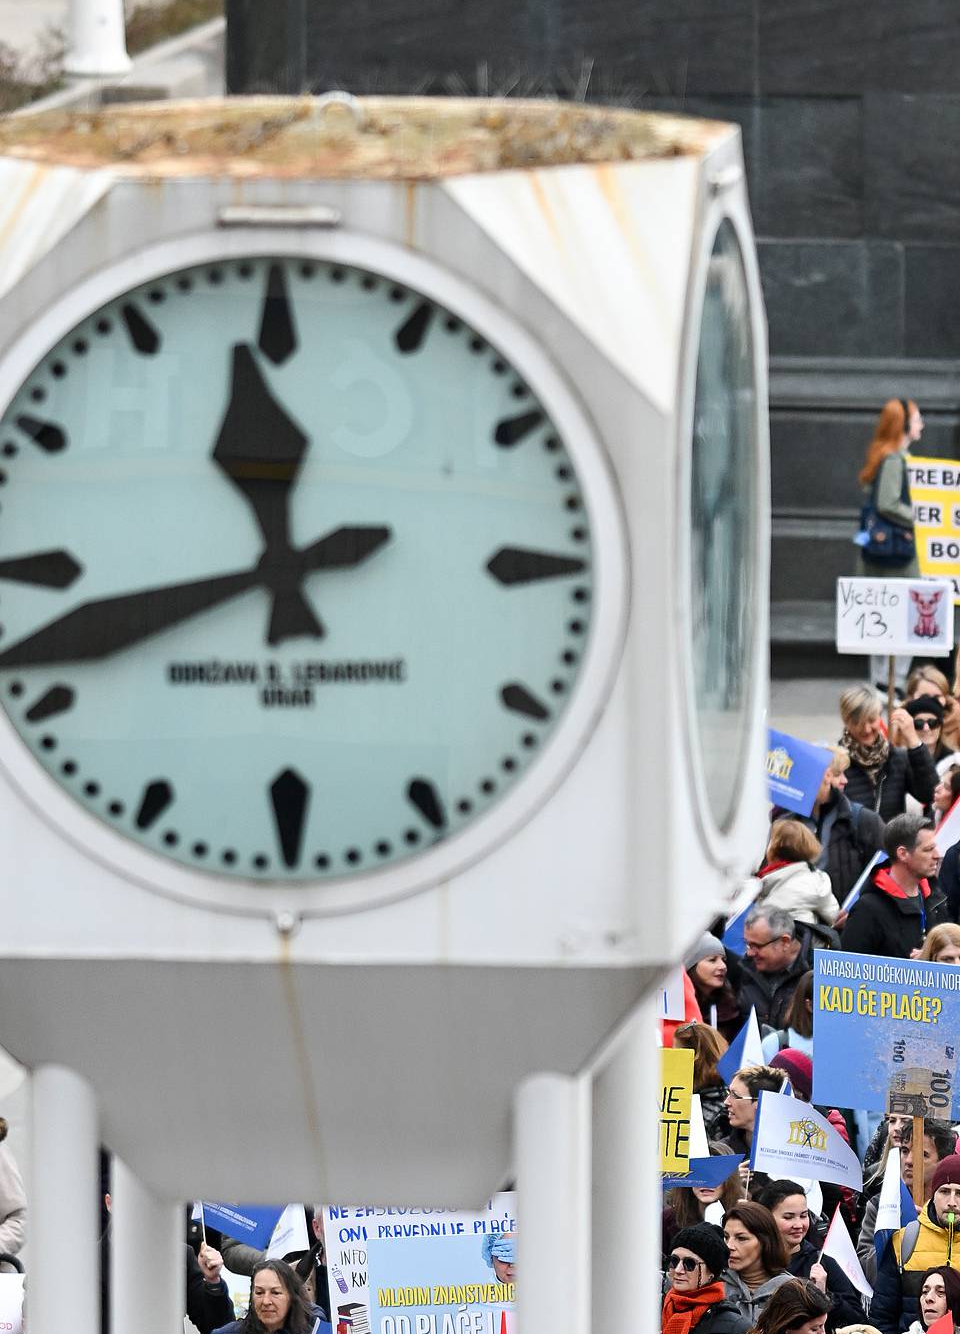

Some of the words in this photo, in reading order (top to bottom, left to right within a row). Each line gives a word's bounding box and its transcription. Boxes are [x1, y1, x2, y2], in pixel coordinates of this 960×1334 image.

[819, 958, 861, 980] NARASLA
[863, 965, 875, 981] SU
[877, 963, 935, 989] OČEKIVANJA
[936, 974, 941, 988] I
[819, 985, 853, 1014] KAD
[857, 984, 877, 1016] ĆE
[880, 990, 942, 1024] PLAĆE?
[929, 1069, 952, 1108] 100
[338, 1225, 368, 1244] ONI
[339, 1249, 368, 1267] INFO
[378, 1286, 430, 1308] MLADIM
